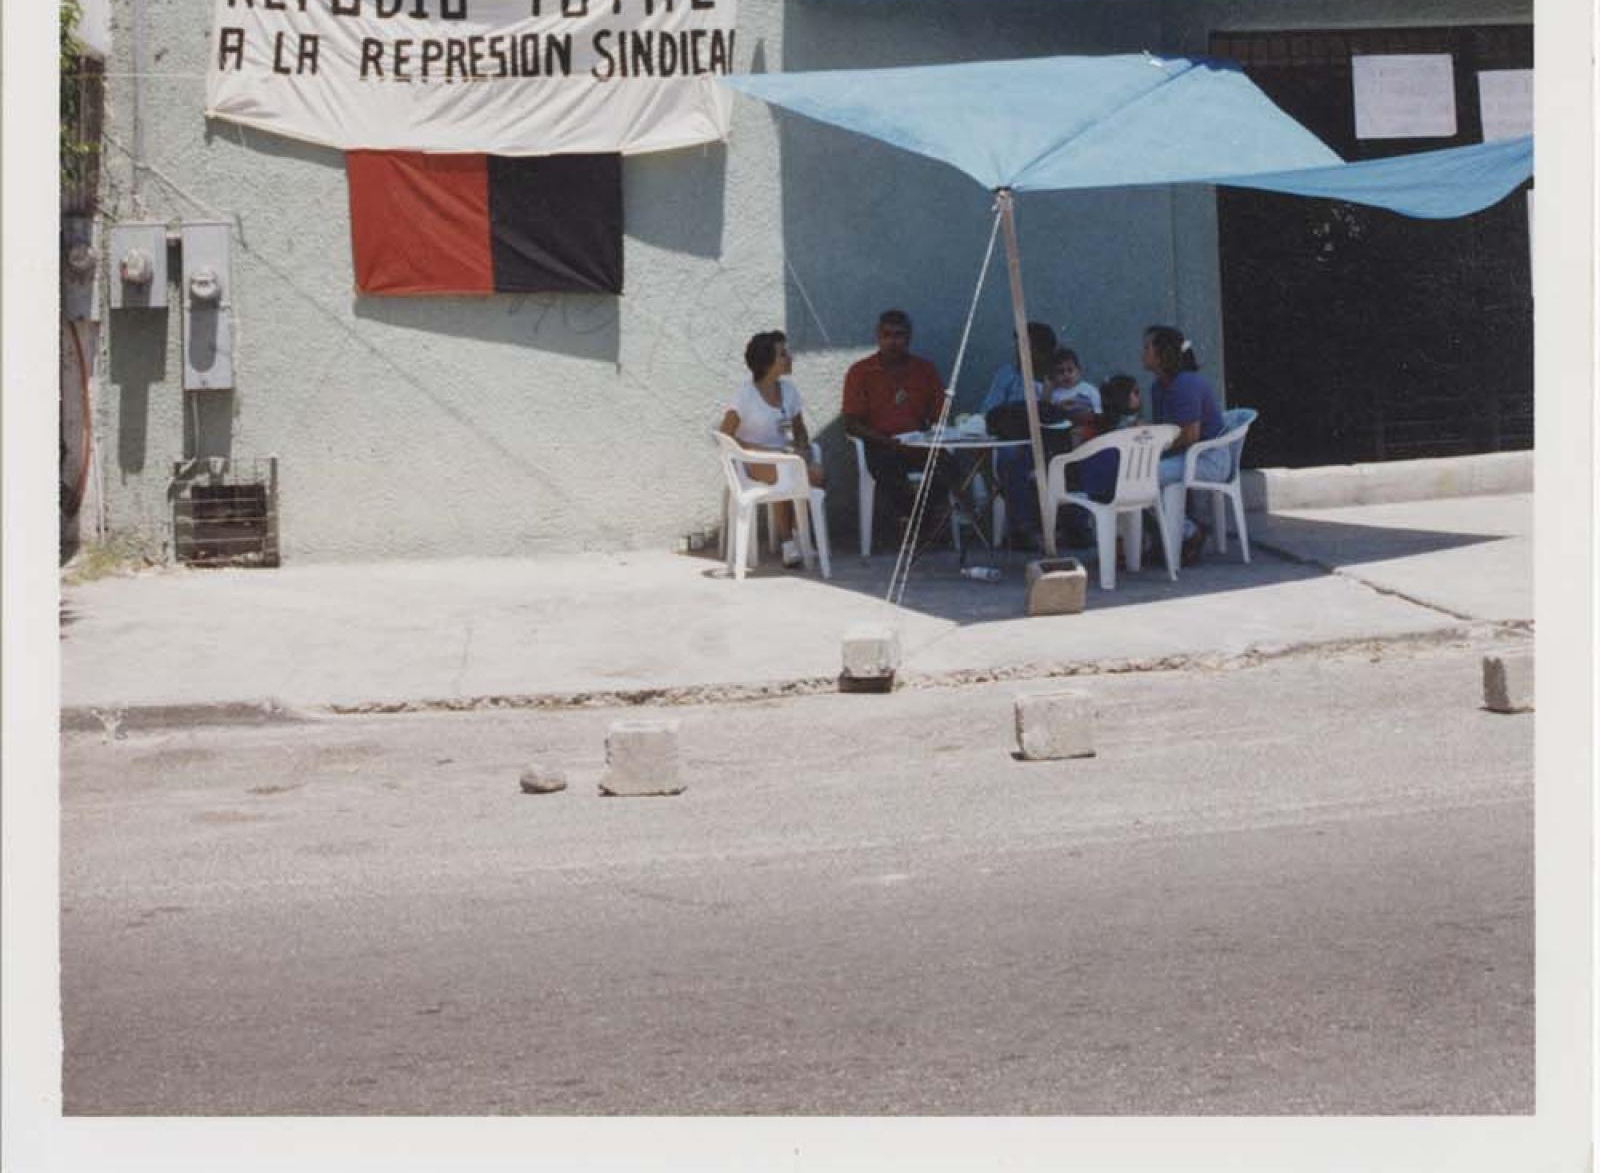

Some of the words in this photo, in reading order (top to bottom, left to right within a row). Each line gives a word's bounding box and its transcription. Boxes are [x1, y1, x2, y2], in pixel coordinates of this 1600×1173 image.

[218, 27, 245, 71] A
[272, 30, 319, 74] LA
[360, 32, 572, 82] REPRESION
